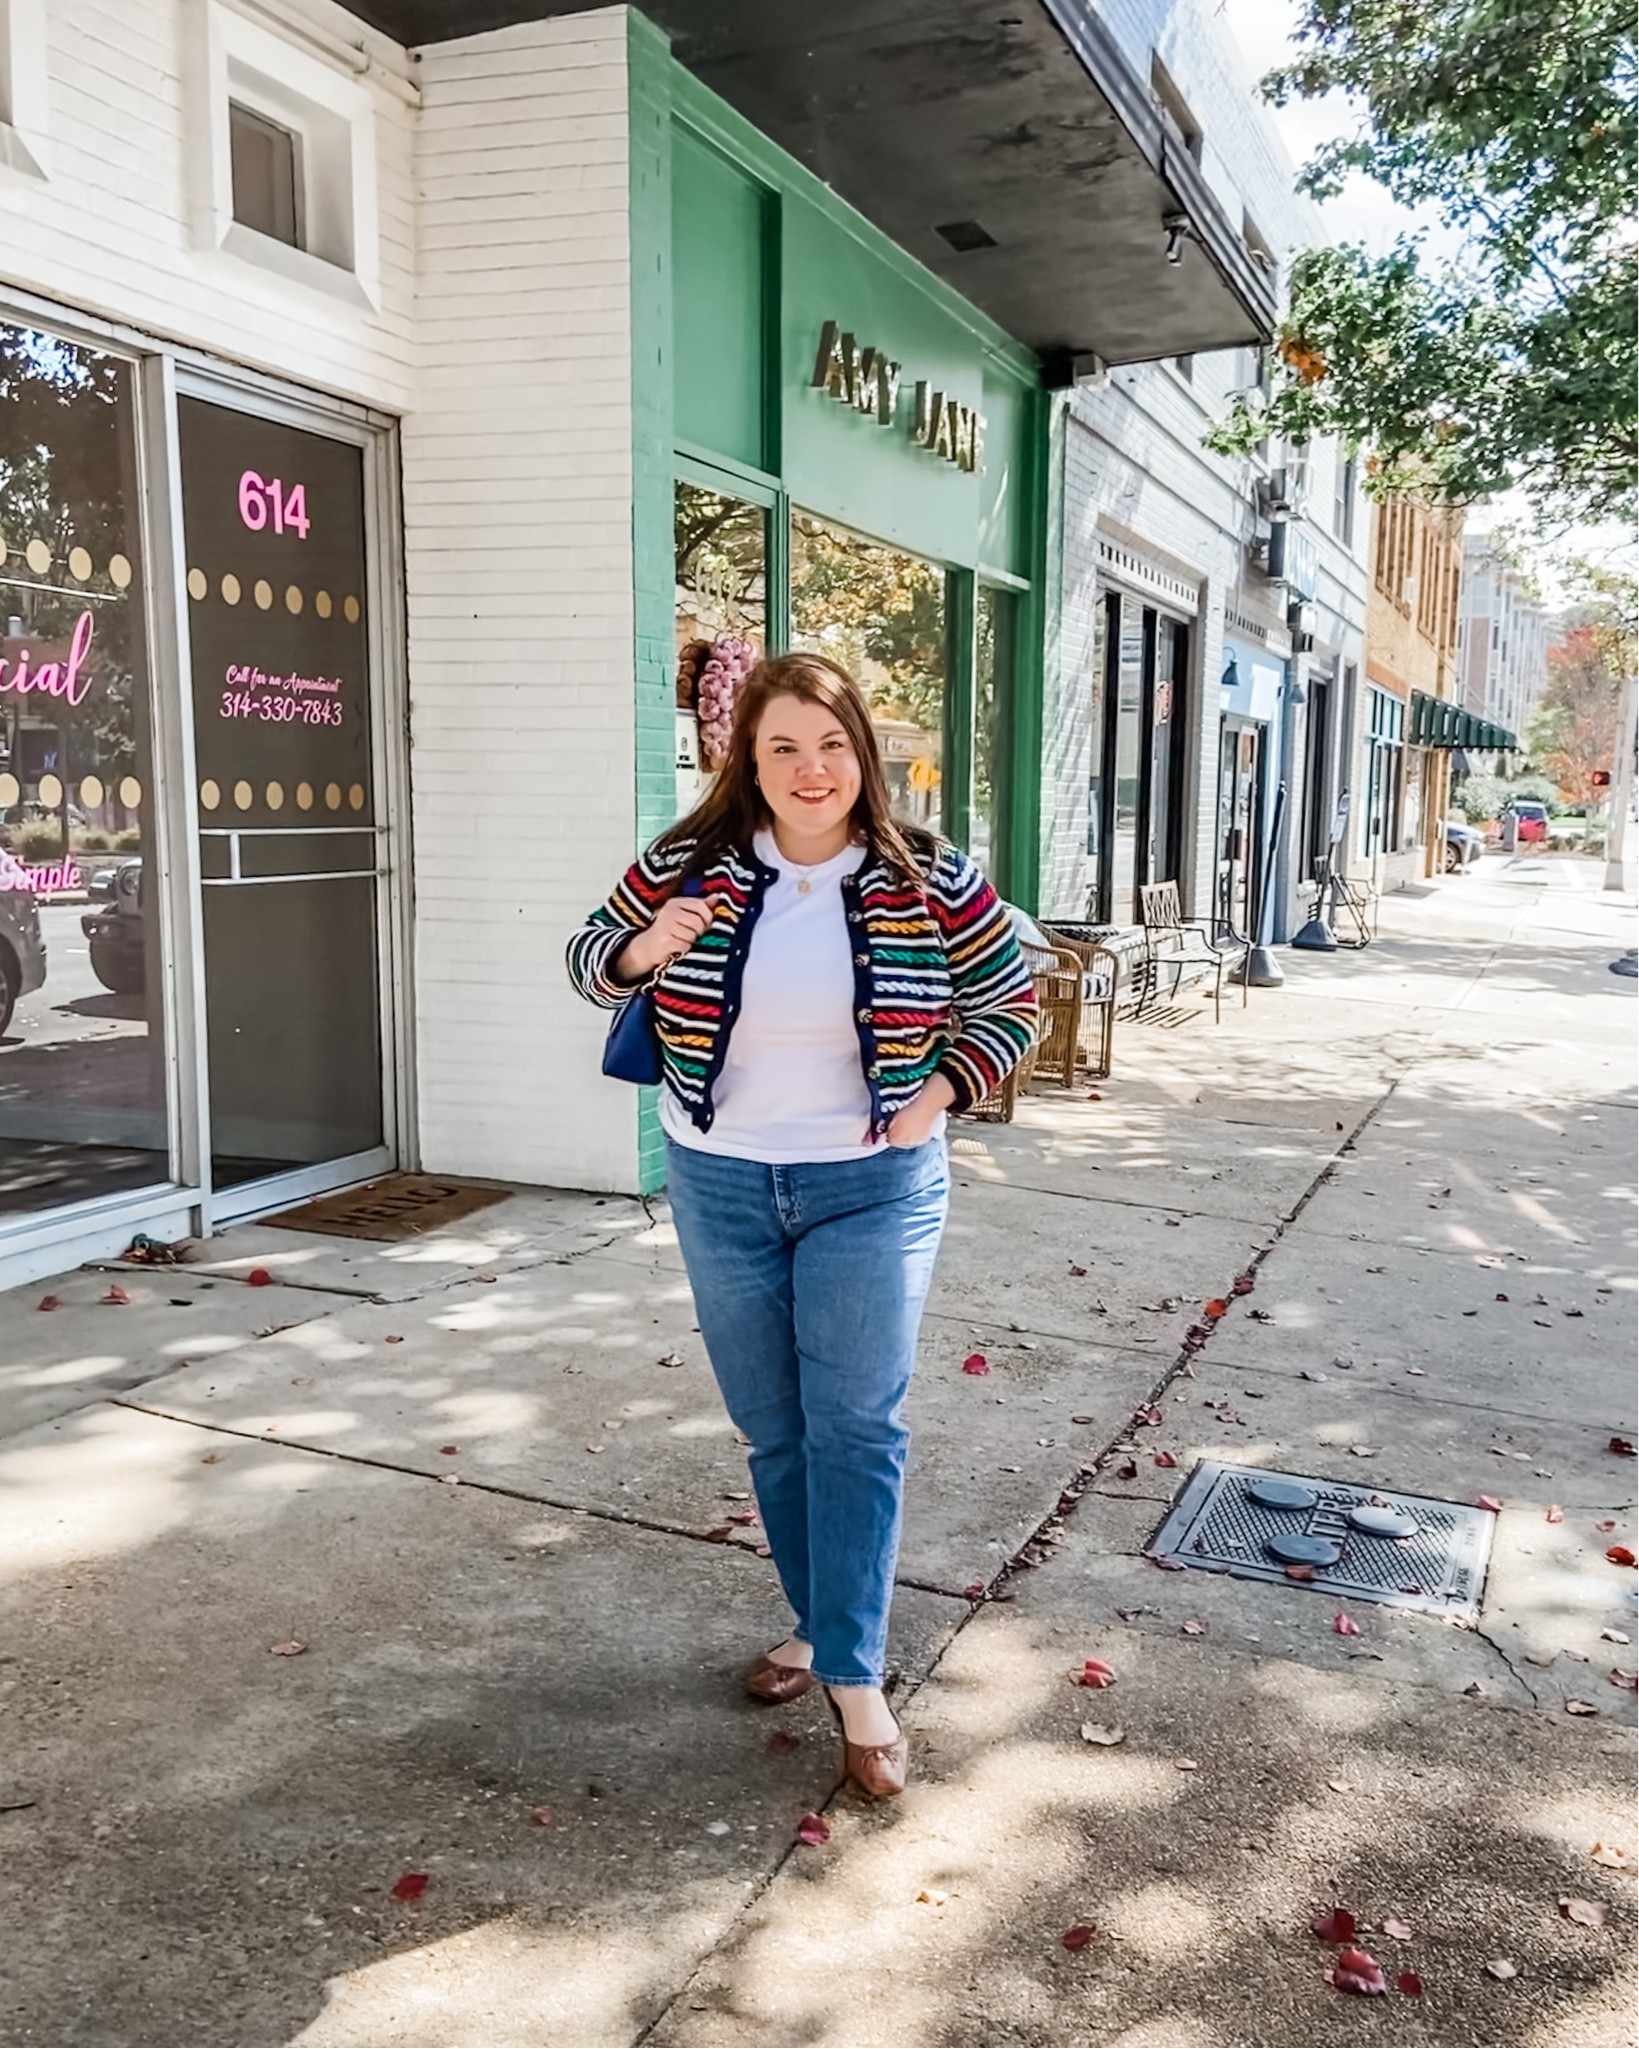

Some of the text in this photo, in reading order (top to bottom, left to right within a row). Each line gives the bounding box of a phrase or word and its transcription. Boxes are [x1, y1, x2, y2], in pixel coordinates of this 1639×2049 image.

[811, 320, 988, 477] AMY JANE
[238, 470, 310, 539] 614
[226, 665, 250, 684] Call
[250, 667, 266, 691] for
[269, 675, 281, 686] an
[219, 690, 342, 726] 314-330-7843
[0, 854, 82, 903] Simple
